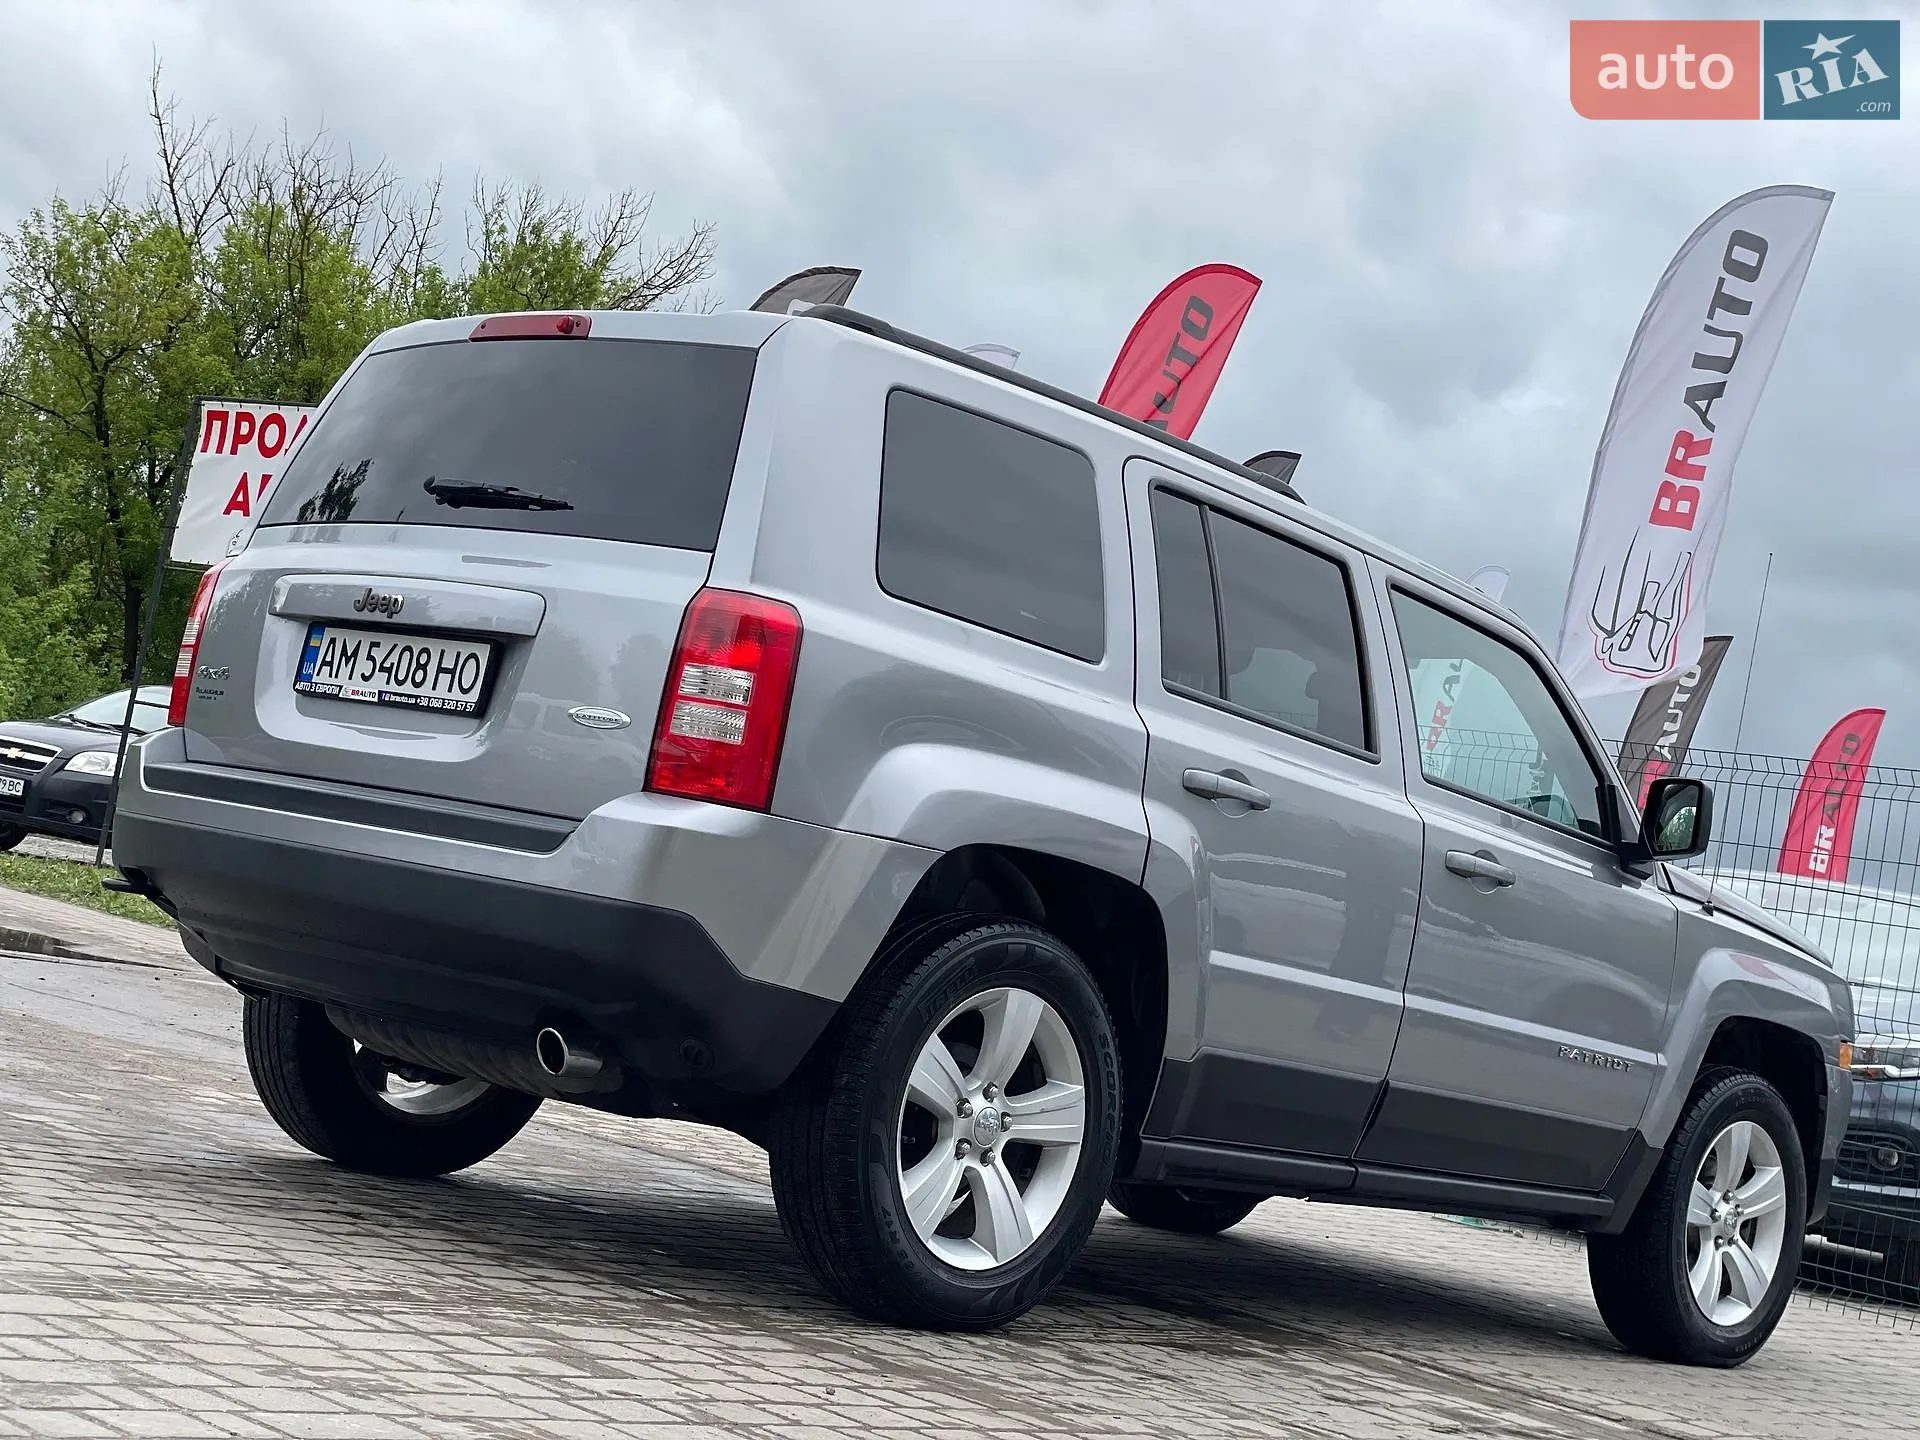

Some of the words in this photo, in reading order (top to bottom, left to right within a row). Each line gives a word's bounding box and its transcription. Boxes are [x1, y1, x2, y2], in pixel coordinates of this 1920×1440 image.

[1648, 228, 1769, 531] BRAUTO
[353, 588, 405, 618] Jeep
[302, 661, 314, 676] UA
[316, 637, 360, 681] AM
[361, 641, 433, 688] 5408
[432, 649, 481, 695] HO
[295, 682, 311, 692] АВТО
[351, 689, 377, 699] BRAUTO
[416, 697, 428, 707] +38
[429, 698, 443, 708] 068
[442, 699, 457, 710] 320
[456, 701, 466, 711] 57
[465, 702, 476, 712] 57
[1558, 1045, 1635, 1073] PATRIOT
